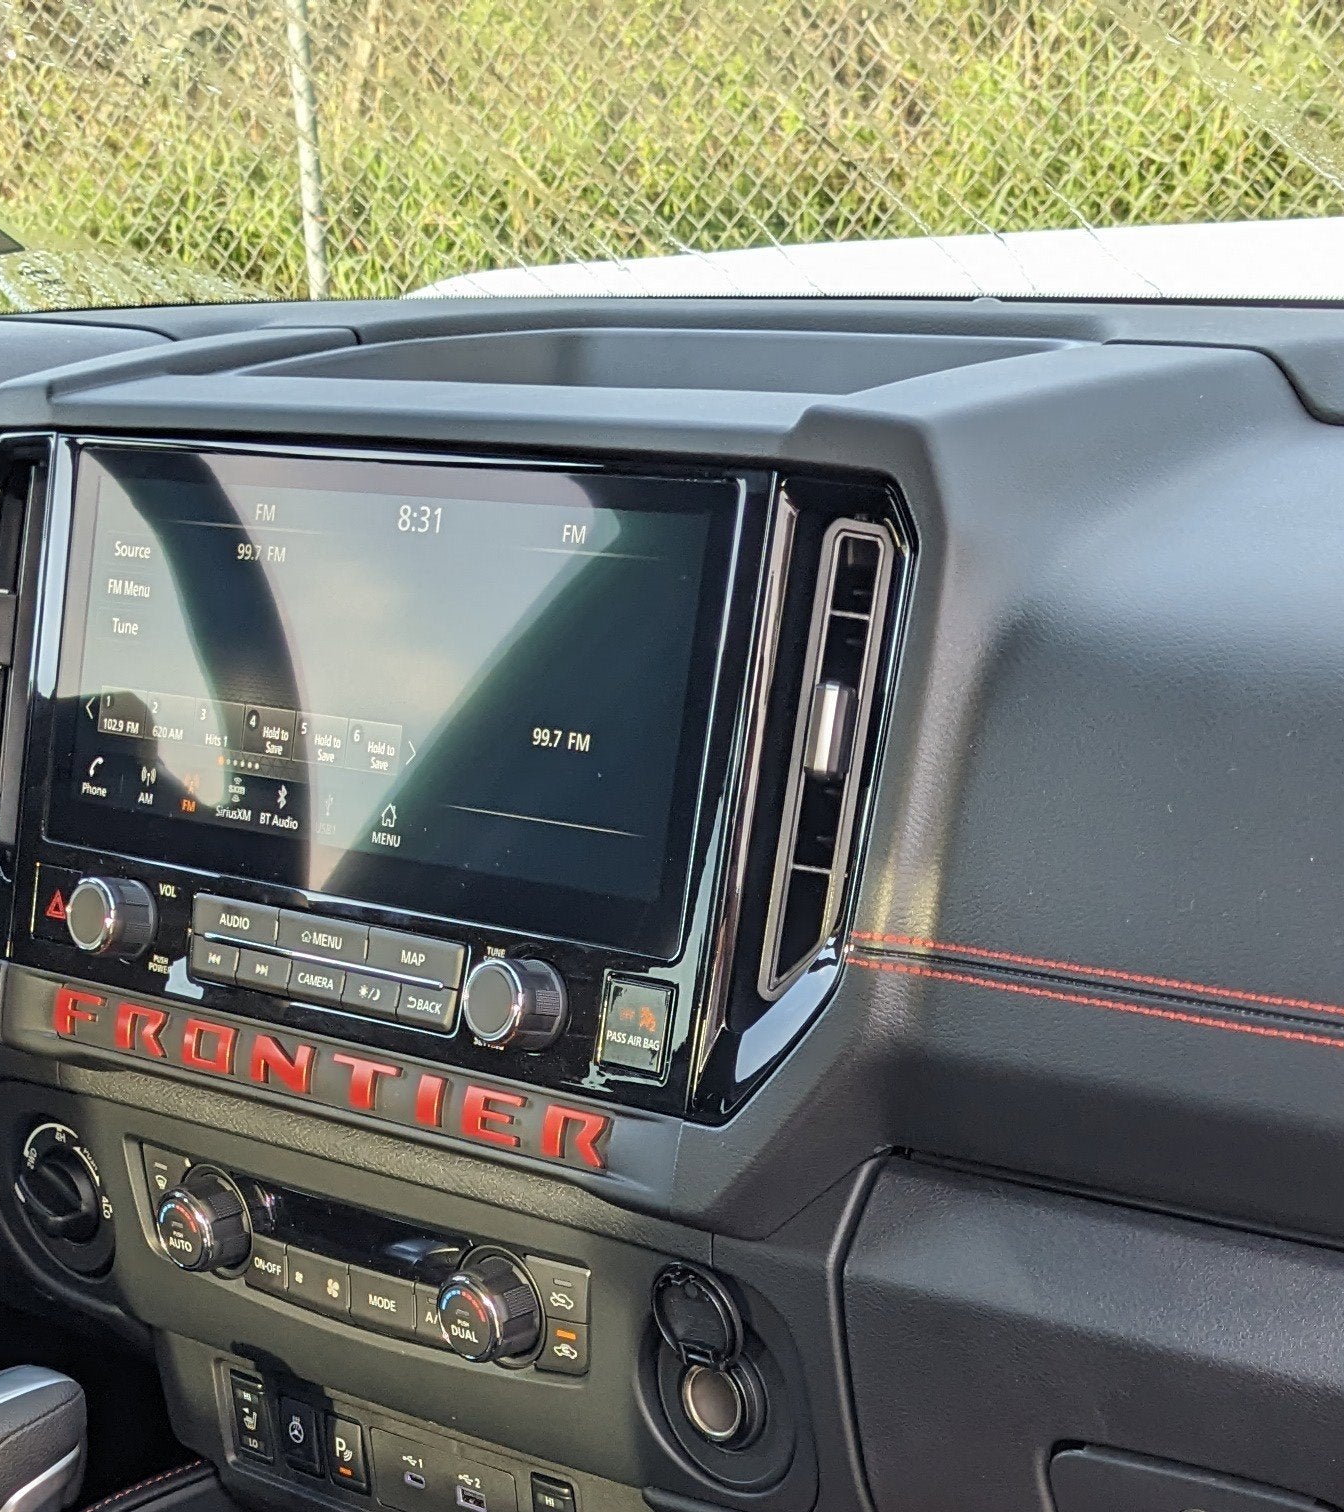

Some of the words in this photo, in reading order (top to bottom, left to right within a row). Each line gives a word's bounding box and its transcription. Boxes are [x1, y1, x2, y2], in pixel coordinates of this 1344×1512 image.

[255, 504, 276, 522] FM
[397, 504, 442, 534] 8:31
[562, 524, 586, 544] FM
[114, 541, 151, 559] Source
[236, 543, 261, 561] 99.7
[267, 546, 286, 562] FM
[108, 579, 122, 595] FM
[124, 580, 150, 598] Menu
[112, 617, 138, 635] Tune
[152, 702, 158, 714] 2
[200, 708, 206, 721] 3
[126, 721, 139, 735] FM
[249, 715, 256, 728] 4
[302, 723, 308, 735] 5
[167, 728, 184, 741] AM
[205, 733, 221, 747] Hits
[262, 726, 280, 740] Hold
[280, 730, 289, 741] to
[314, 734, 332, 747] Hold
[333, 737, 341, 749] to
[353, 730, 360, 742] 6
[532, 727, 563, 748] 99.7
[567, 732, 591, 752] FM
[265, 741, 283, 755] Save
[318, 749, 335, 763] Save
[368, 741, 386, 754] Hold
[386, 745, 395, 756] to
[370, 757, 389, 771] Save
[81, 782, 107, 797] Phone
[138, 792, 154, 805] AM
[182, 799, 196, 812] FM
[215, 805, 252, 822] SiriusXM
[259, 812, 270, 825] BT
[272, 814, 299, 830] Audio
[371, 831, 401, 848] MENU
[159, 883, 177, 898] VOL
[219, 913, 250, 930] AUDIO
[312, 933, 343, 950] MENU
[400, 949, 426, 967] MAP
[297, 972, 334, 990] CAMERA
[416, 996, 443, 1015] BACK
[607, 1029, 627, 1044] PASS
[628, 1035, 642, 1048] AIR
[643, 1037, 660, 1052] BAG
[56, 981, 614, 1171] FRONTIER
[169, 1236, 192, 1253] AUTO
[254, 1257, 281, 1276] ON-OFF
[368, 1294, 397, 1313] MODE
[425, 1311, 438, 1325] A/
[451, 1324, 479, 1344] DUAL
[336, 1437, 346, 1457] P
